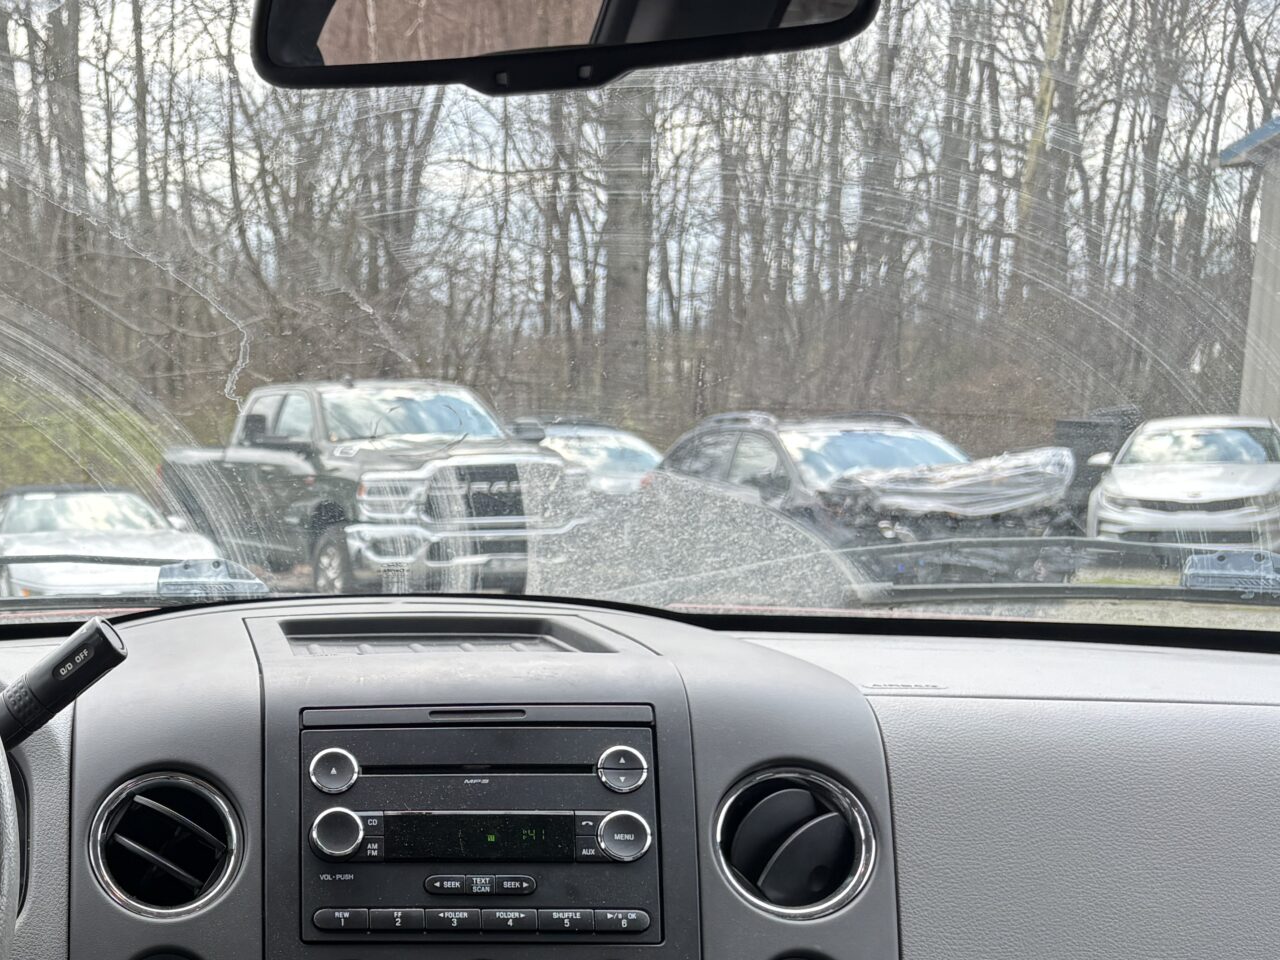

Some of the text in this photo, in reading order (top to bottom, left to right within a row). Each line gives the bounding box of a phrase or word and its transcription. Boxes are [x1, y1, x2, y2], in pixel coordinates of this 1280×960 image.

[74, 648, 89, 663] OFF
[367, 818, 378, 826] CD
[613, 833, 635, 841] MENU
[366, 842, 378, 850] AM
[367, 849, 378, 857] FM
[581, 848, 596, 856] AUX
[443, 881, 461, 889] SEEK
[472, 885, 490, 893] SCAN
[503, 881, 521, 889] SEEK
[334, 911, 350, 919] REW
[393, 911, 403, 919] FF
[444, 911, 468, 919] FOLDER
[496, 911, 520, 919] FOLDER
[627, 912, 637, 920] OK
[395, 918, 402, 927] 2
[451, 918, 458, 927] 3
[507, 918, 513, 927] 4
[563, 919, 570, 928] 5
[621, 919, 628, 928] 6
